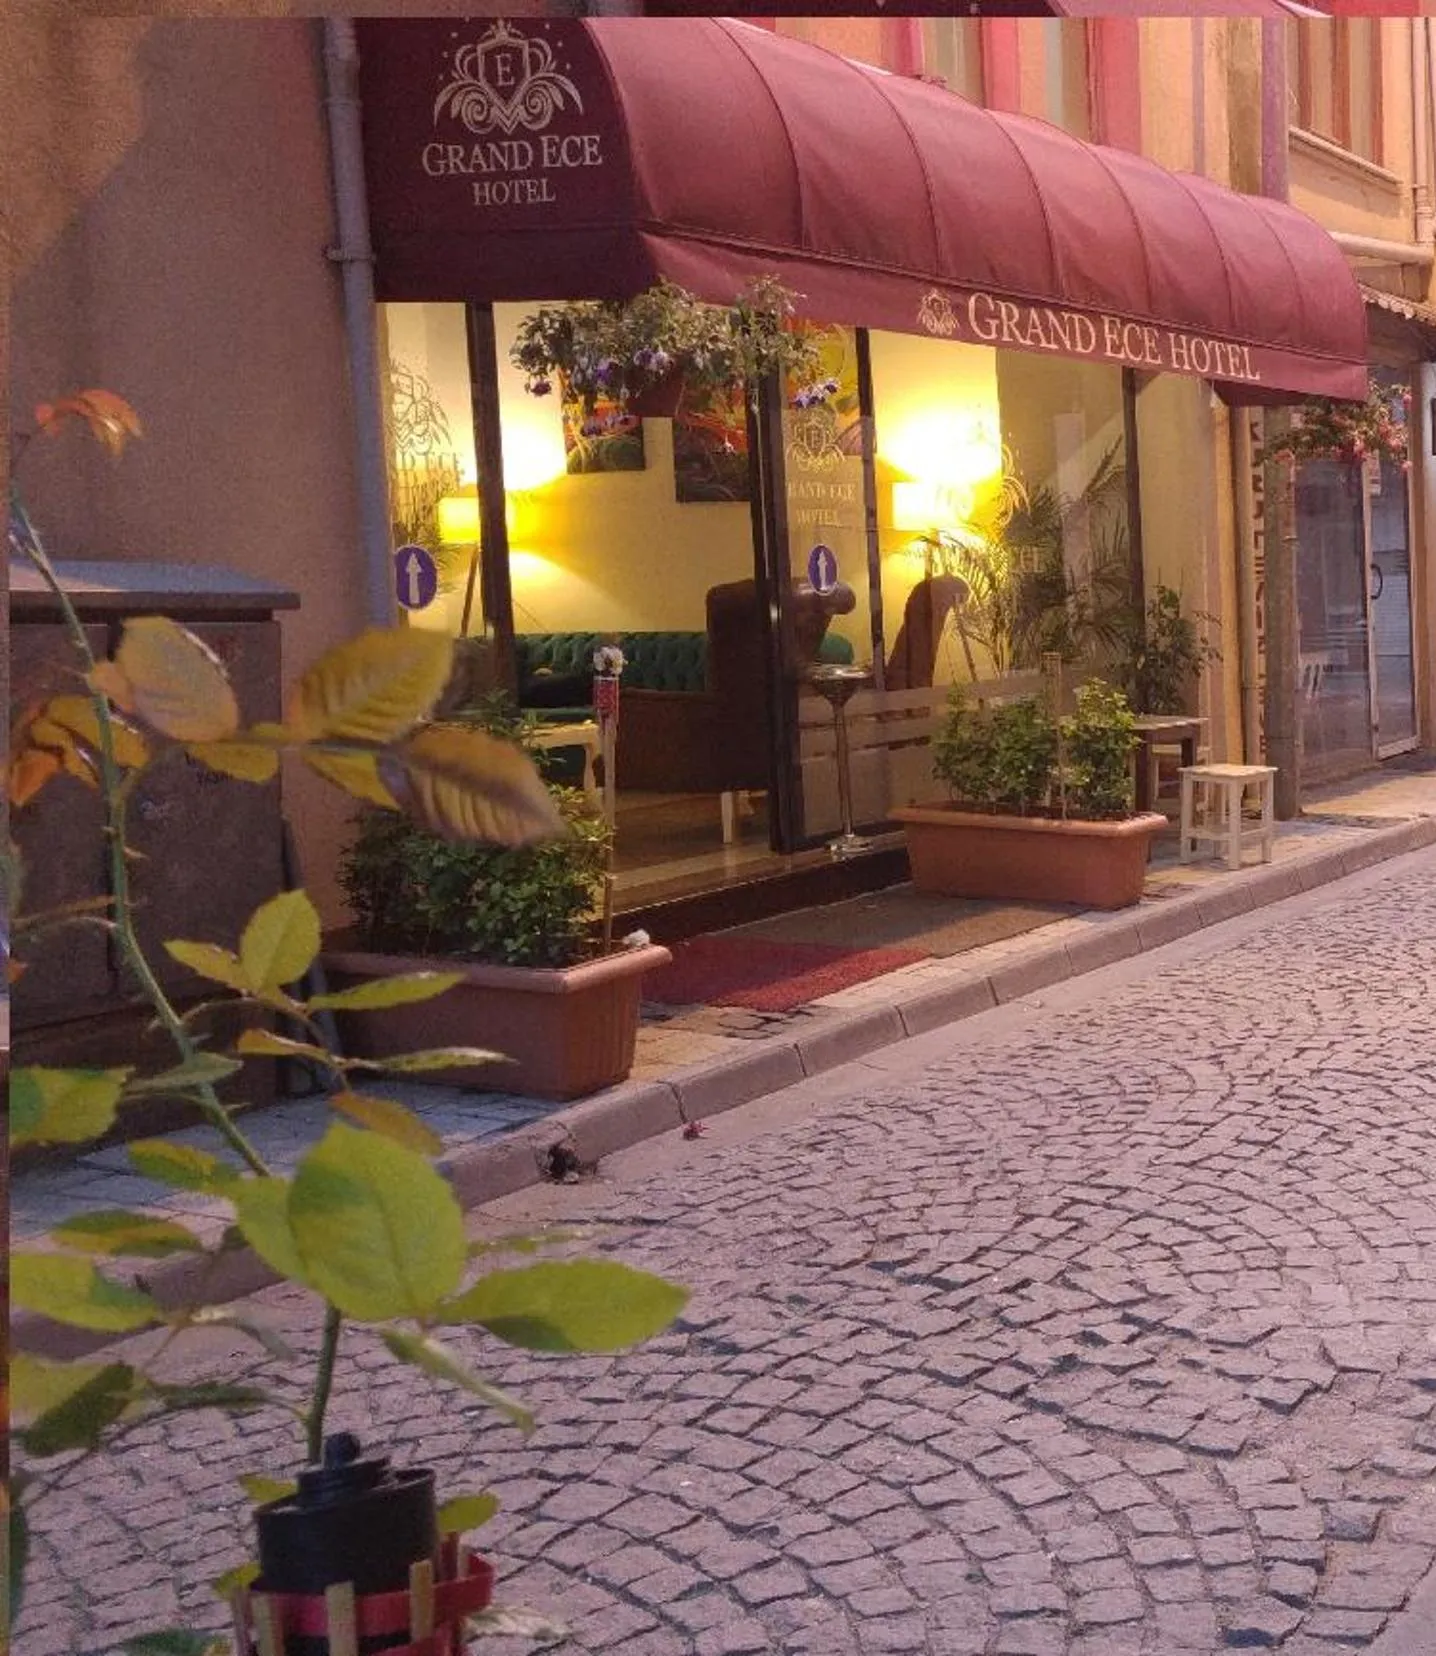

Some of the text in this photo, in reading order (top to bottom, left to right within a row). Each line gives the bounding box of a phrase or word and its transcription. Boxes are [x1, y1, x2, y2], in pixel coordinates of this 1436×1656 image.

[495, 53, 516, 86] E
[421, 134, 602, 177] GRAND ECE
[472, 178, 556, 206] HOTEL
[967, 292, 1261, 381] GRAND ECE HOTEL
